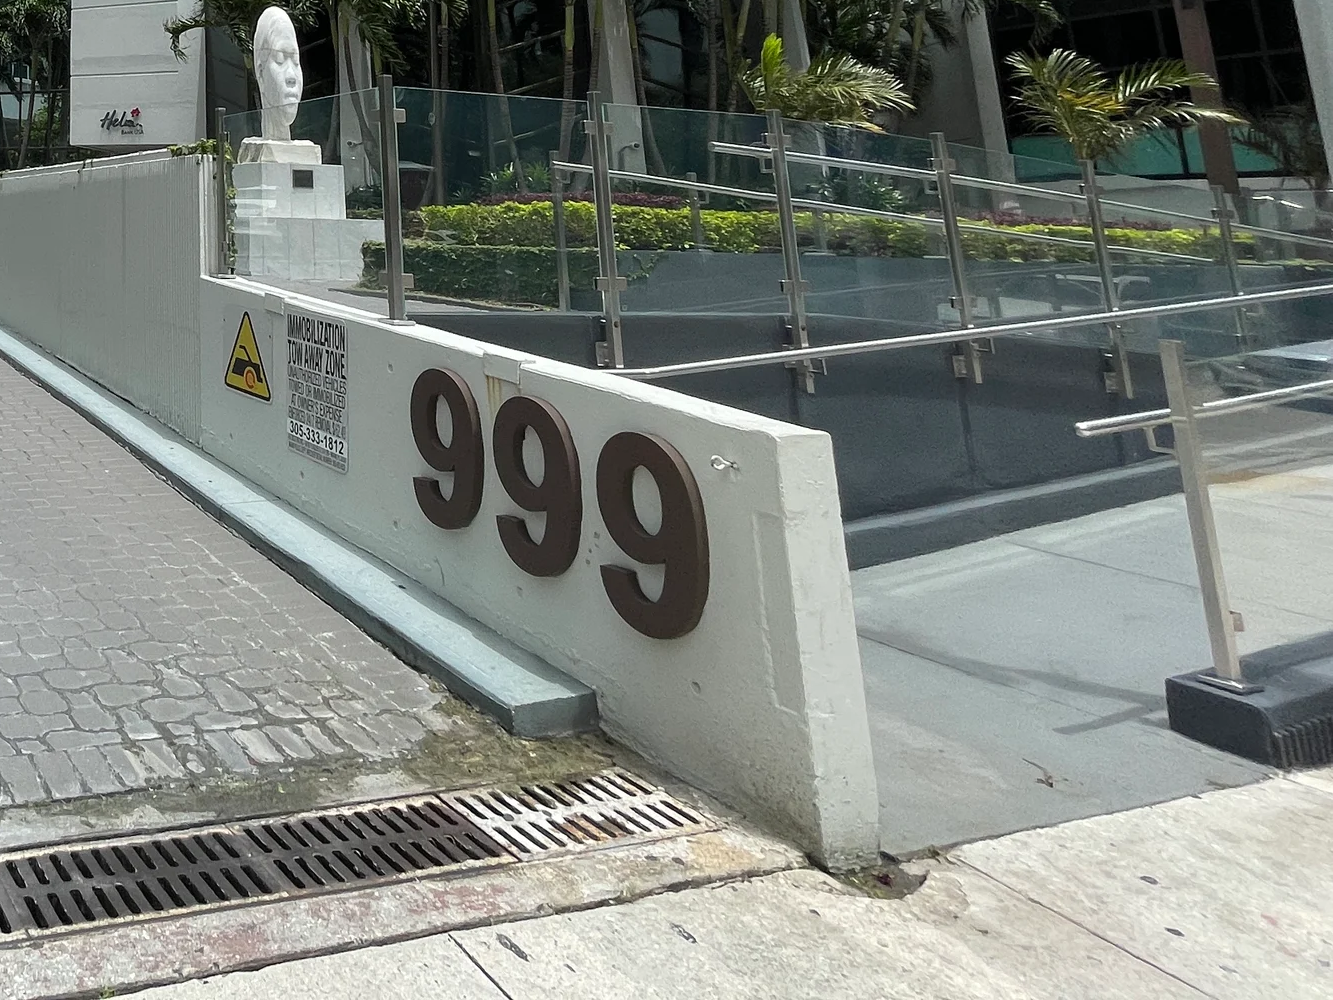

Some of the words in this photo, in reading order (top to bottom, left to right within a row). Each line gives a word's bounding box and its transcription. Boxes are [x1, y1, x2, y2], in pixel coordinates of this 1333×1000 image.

[287, 313, 345, 352] IMMOBILIZATION
[287, 339, 303, 366] TOW
[304, 343, 323, 373] AWAY
[325, 349, 346, 379] ZONE
[289, 420, 344, 455] 305-333-1812
[409, 367, 711, 640] 999
